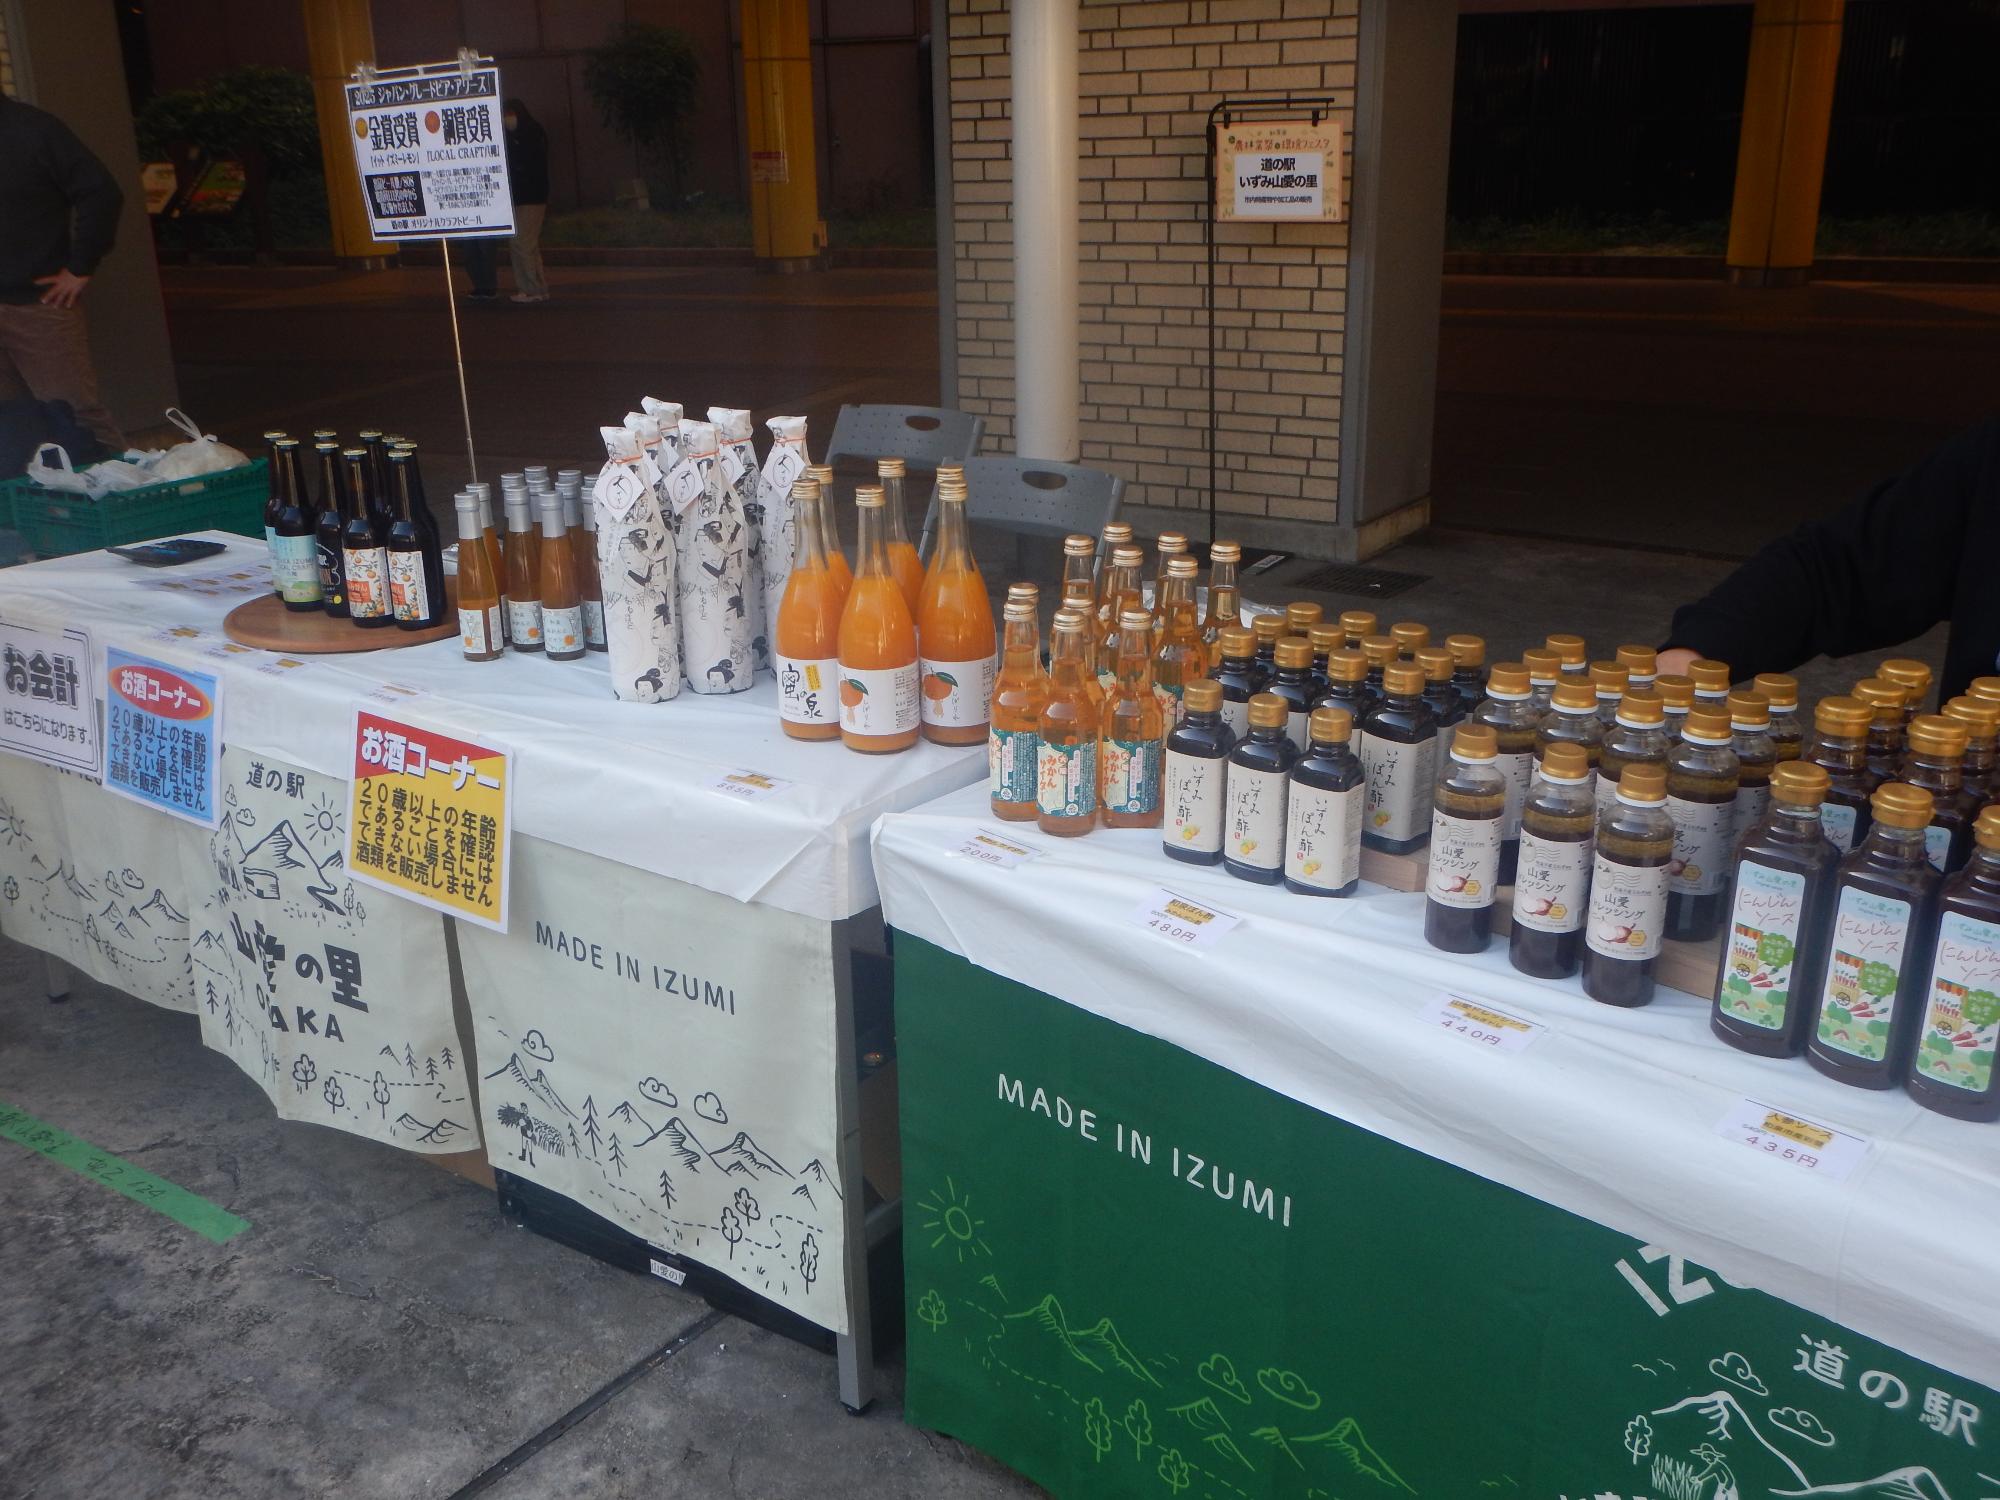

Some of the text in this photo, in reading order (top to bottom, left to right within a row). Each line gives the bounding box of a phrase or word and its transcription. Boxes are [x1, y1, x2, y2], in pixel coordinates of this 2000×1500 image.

[368, 111, 420, 151] 金賞受賞
[1240, 175, 1317, 188] いずみ山愛の里
[1261, 158, 1295, 171] 道の駅
[4, 645, 79, 709] お会計
[121, 669, 200, 709] お酒コーナー
[4, 708, 92, 745] はこちらになります。
[361, 726, 500, 791] お酒コーナー
[110, 761, 206, 811] 酒類を販売しません
[247, 761, 304, 799] 道の駅
[359, 799, 496, 864] であることを確認
[358, 821, 494, 885] できない場合には
[1441, 845, 1465, 860] 山愛
[356, 840, 493, 907] 酒類を販売しません
[1527, 866, 1552, 882] 山愛
[1605, 893, 1629, 909] 山愛
[1738, 888, 1796, 911] にんじん
[1149, 920, 1196, 942] 480円
[1755, 911, 1795, 926] ソース
[1839, 914, 1901, 938] にんじん
[1857, 939, 1899, 954] ソース
[536, 921, 735, 1015] MADE IN IZUMI
[1442, 1020, 1501, 1045] 440円
[998, 1073, 1290, 1227] MADE IN IZUMI
[1746, 1136, 1818, 1168] 435円
[1793, 1334, 1979, 1447] 道の駅
